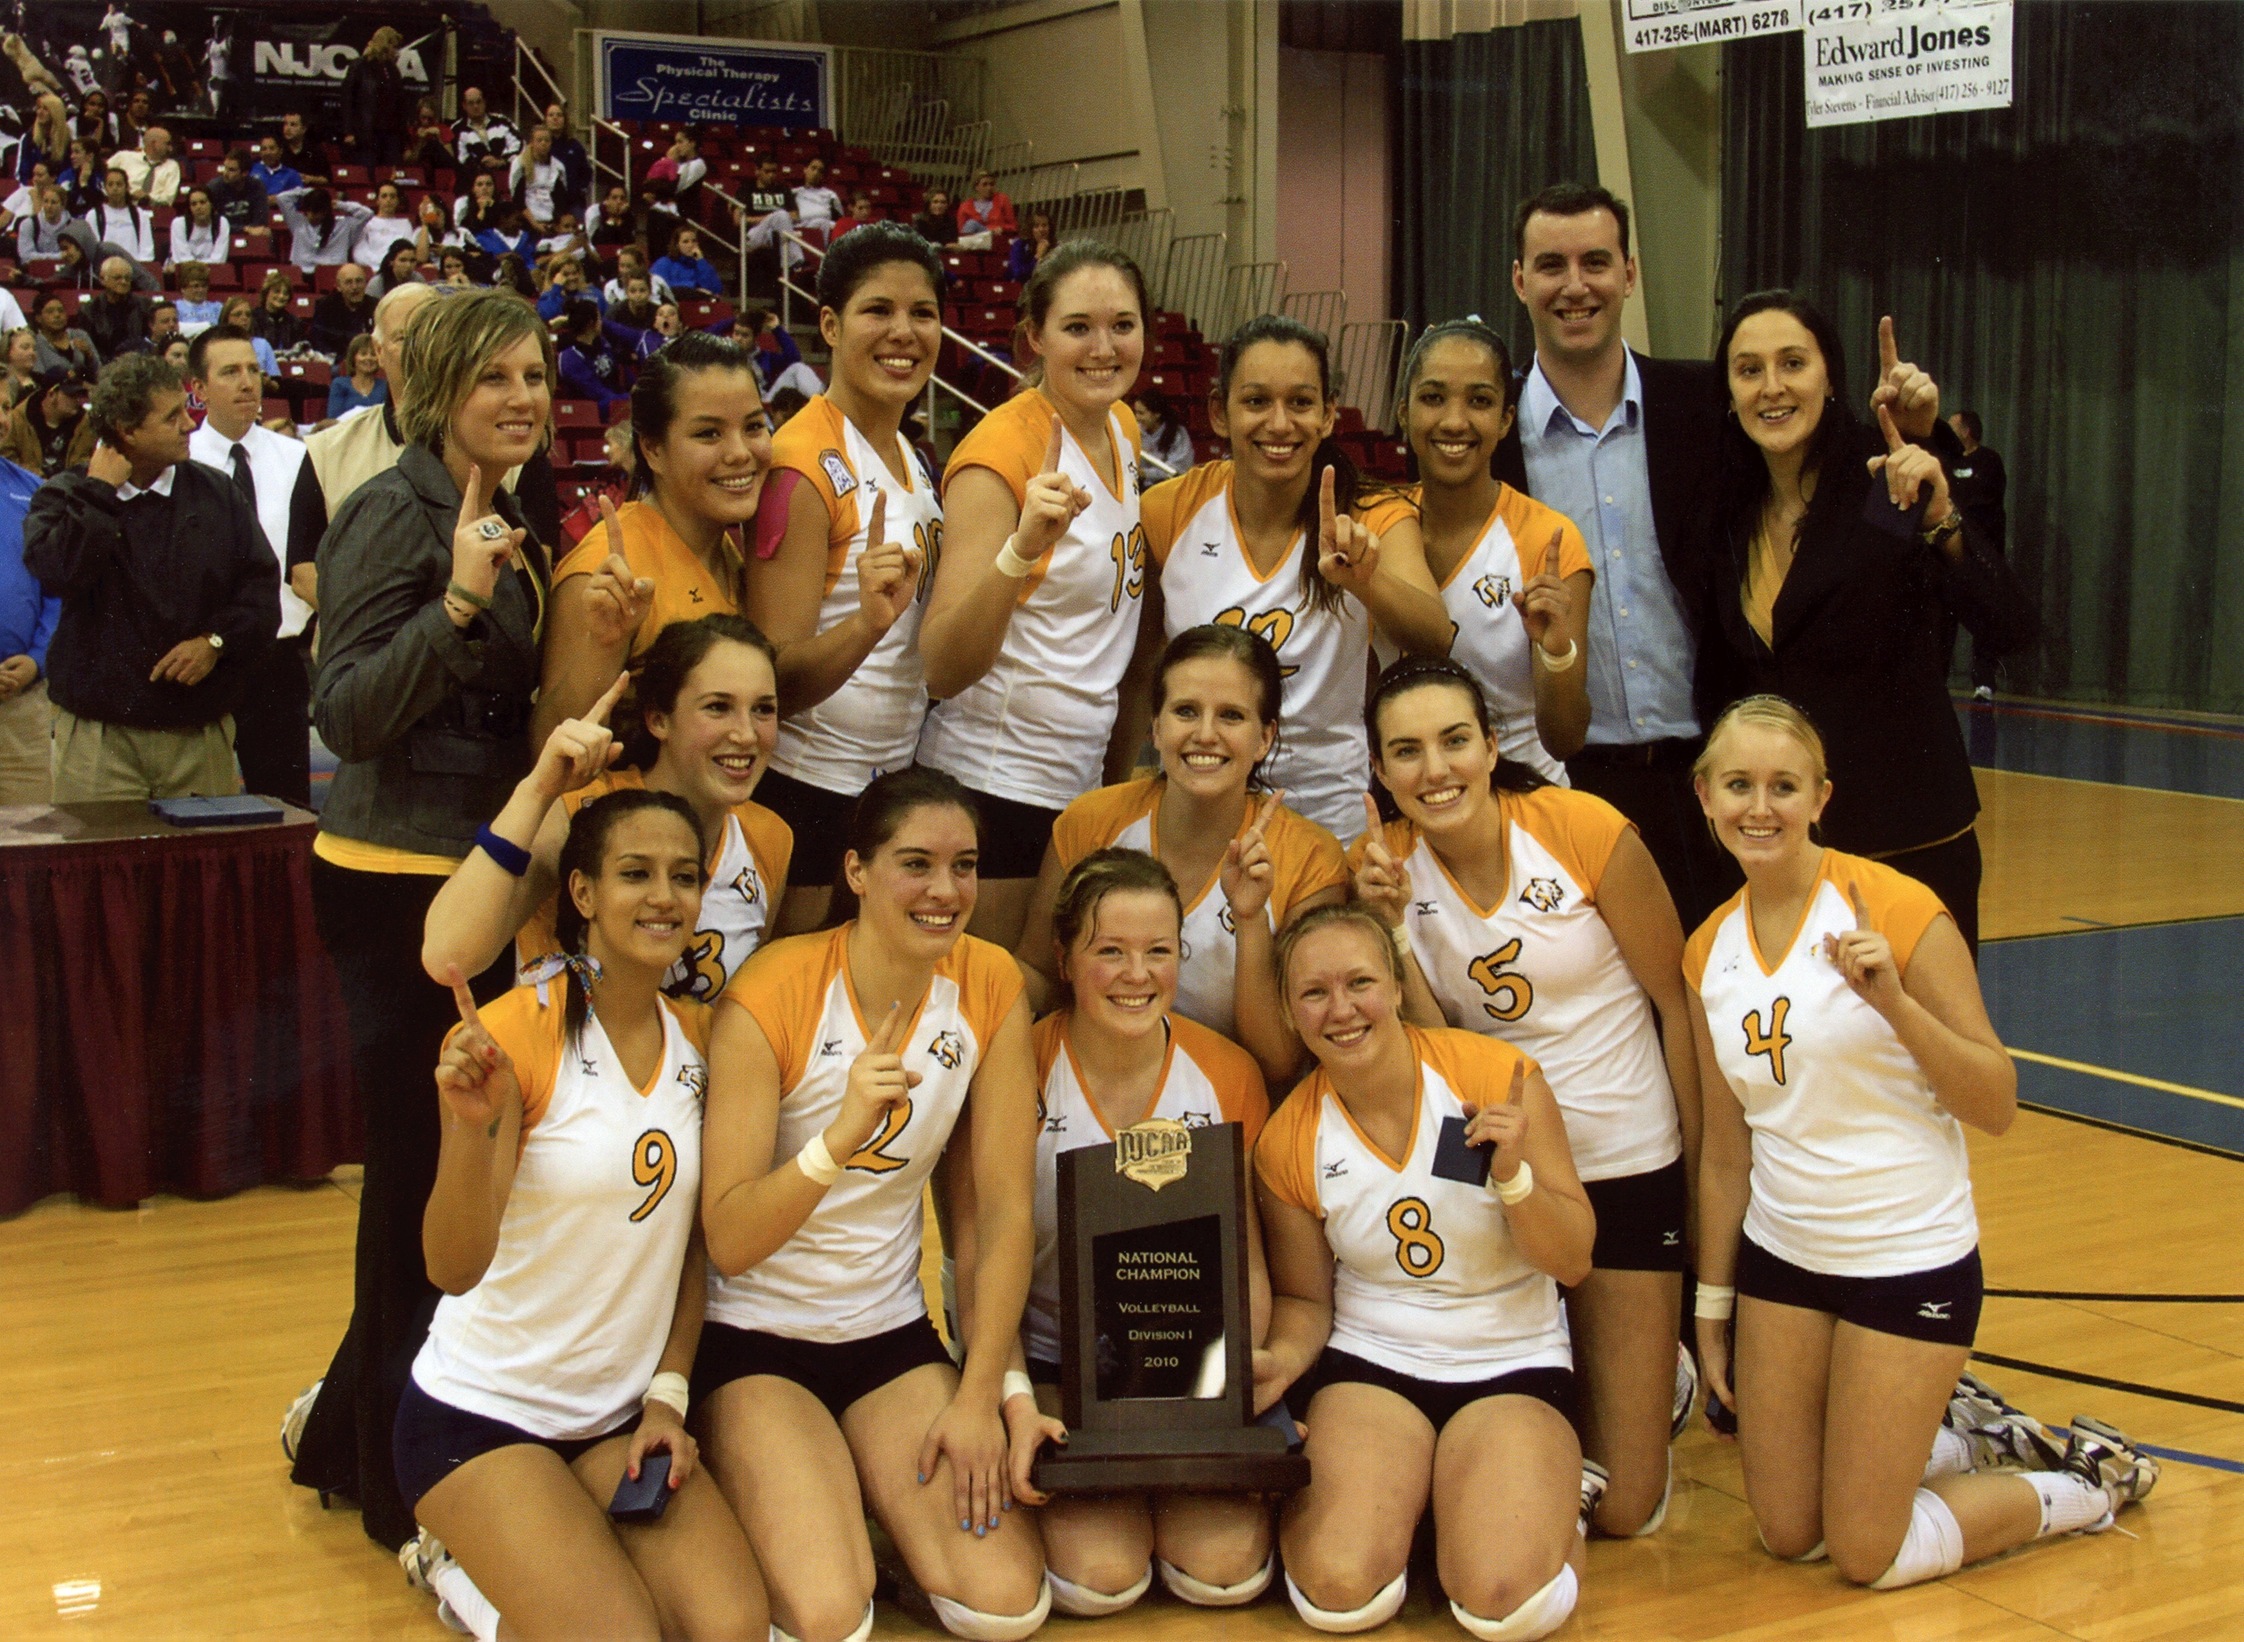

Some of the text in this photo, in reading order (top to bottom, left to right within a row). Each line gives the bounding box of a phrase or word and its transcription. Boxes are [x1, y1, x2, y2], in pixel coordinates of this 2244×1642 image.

[1752, 9, 1790, 31] 6278
[1808, 2, 1873, 26] (417)
[1816, 25, 1991, 68] Edward Jones
[254, 40, 430, 83] NJCA
[656, 63, 780, 83] Physical Therapy
[700, 56, 726, 68] The
[1818, 55, 1990, 87] MAKING SENSE OF INVESTING
[616, 77, 814, 114] Specialists
[1962, 82, 1978, 99] 256
[1986, 78, 2010, 96] 9127
[689, 107, 737, 121] Clinic
[1111, 522, 1147, 613] 13
[1468, 938, 1533, 1022] 5
[1742, 996, 1792, 1086] 4
[845, 1098, 914, 1175] 2
[1119, 1132, 1187, 1166] NJCAA
[629, 1128, 677, 1222] 9
[1386, 1197, 1444, 1278] 8
[1118, 1252, 1198, 1264] NATIONAL
[1116, 1268, 1201, 1281] CHAMPION
[1118, 1302, 1201, 1313] VOLLEYBALL
[1128, 1329, 1193, 1340] DIVISION I
[1144, 1356, 1179, 1368] 2010
